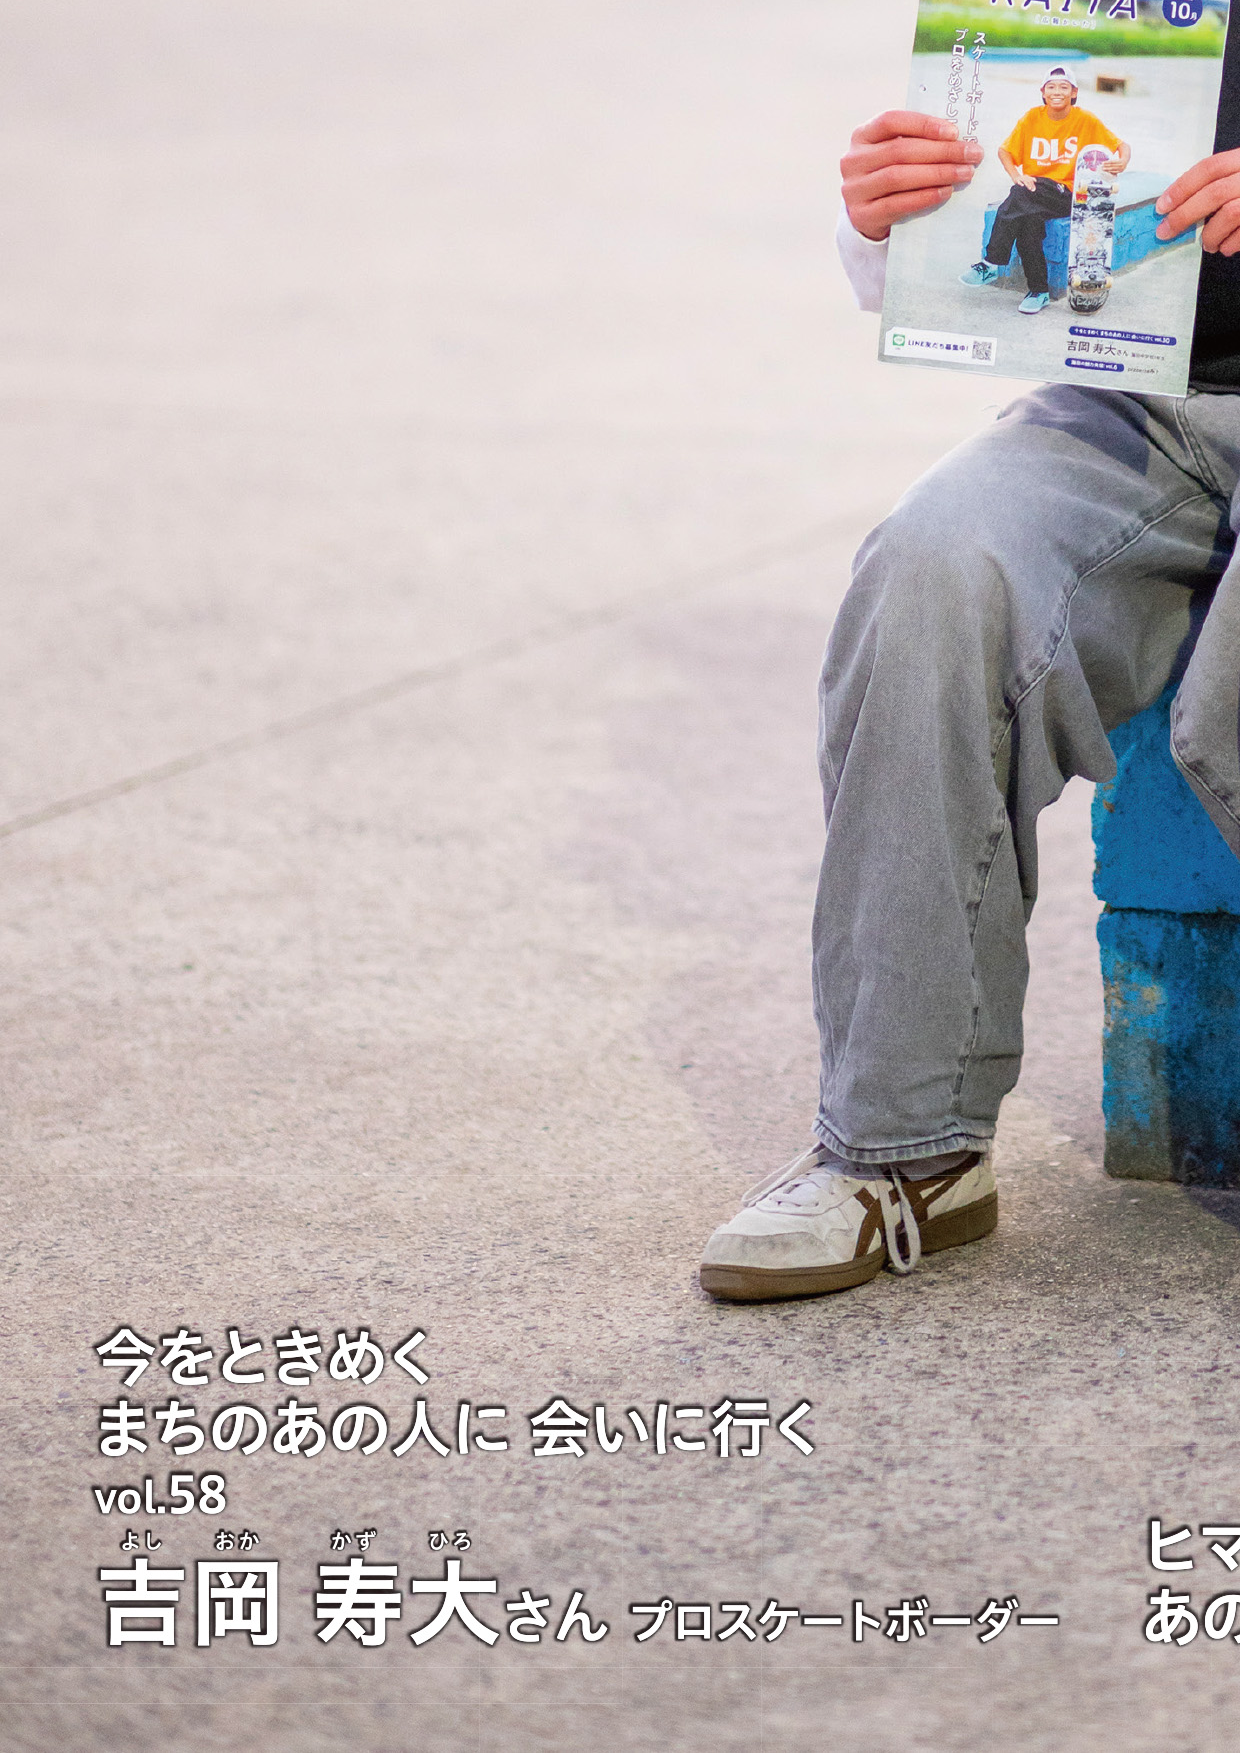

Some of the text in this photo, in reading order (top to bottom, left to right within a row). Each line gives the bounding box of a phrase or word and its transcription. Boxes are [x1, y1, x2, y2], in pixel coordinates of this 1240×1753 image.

[946, 28, 969, 124] プロをめざし
[1030, 136, 1078, 162] DLS
[1066, 340, 1090, 353] 吉岡
